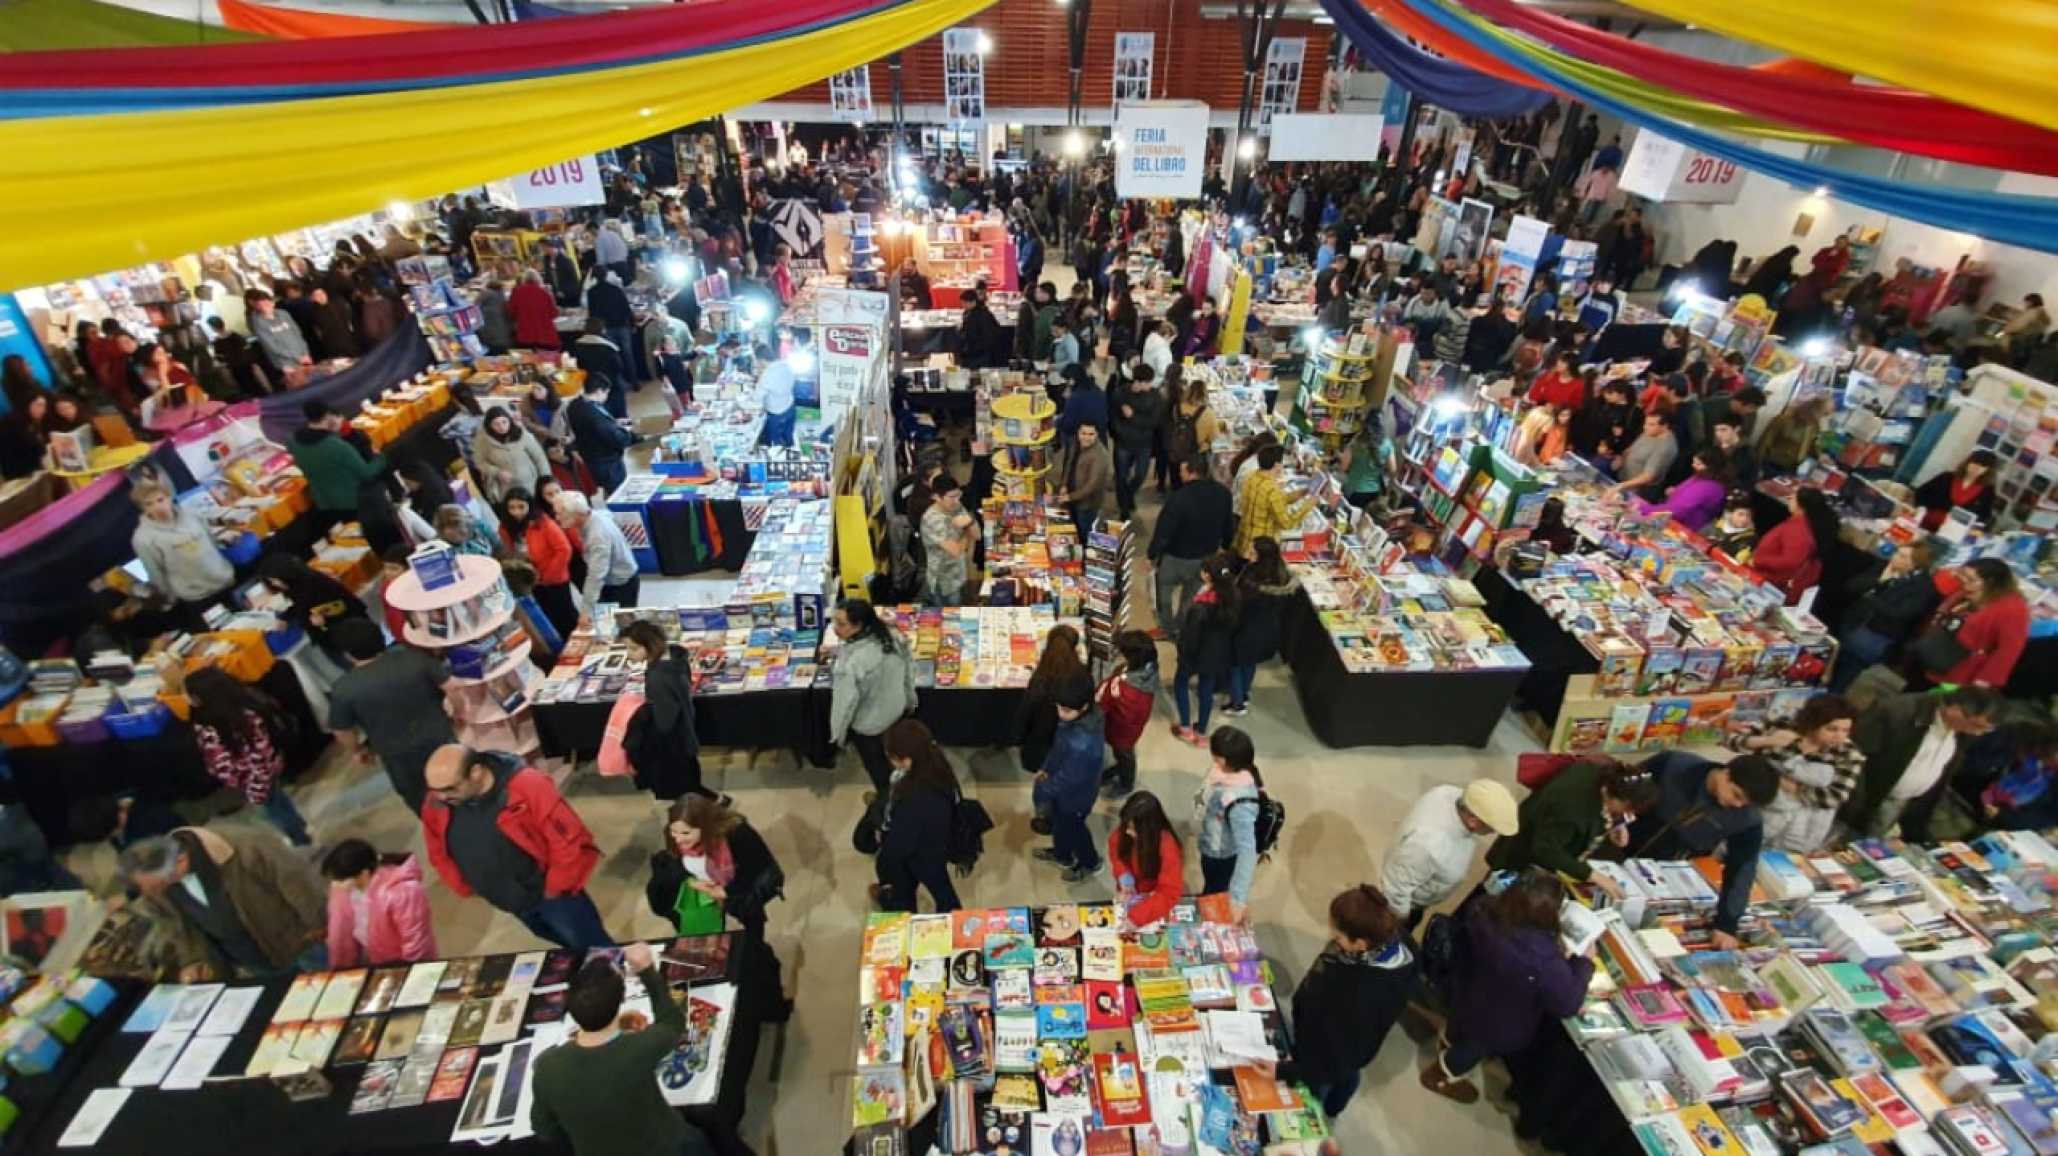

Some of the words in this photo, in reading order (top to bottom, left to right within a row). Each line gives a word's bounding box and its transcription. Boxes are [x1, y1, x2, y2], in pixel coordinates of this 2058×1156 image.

[1134, 128, 1166, 143] FERIA
[529, 158, 584, 187] 2019
[1133, 157, 1153, 171] DEL
[1155, 157, 1187, 171] LIBRO
[1685, 158, 1737, 183] 2019
